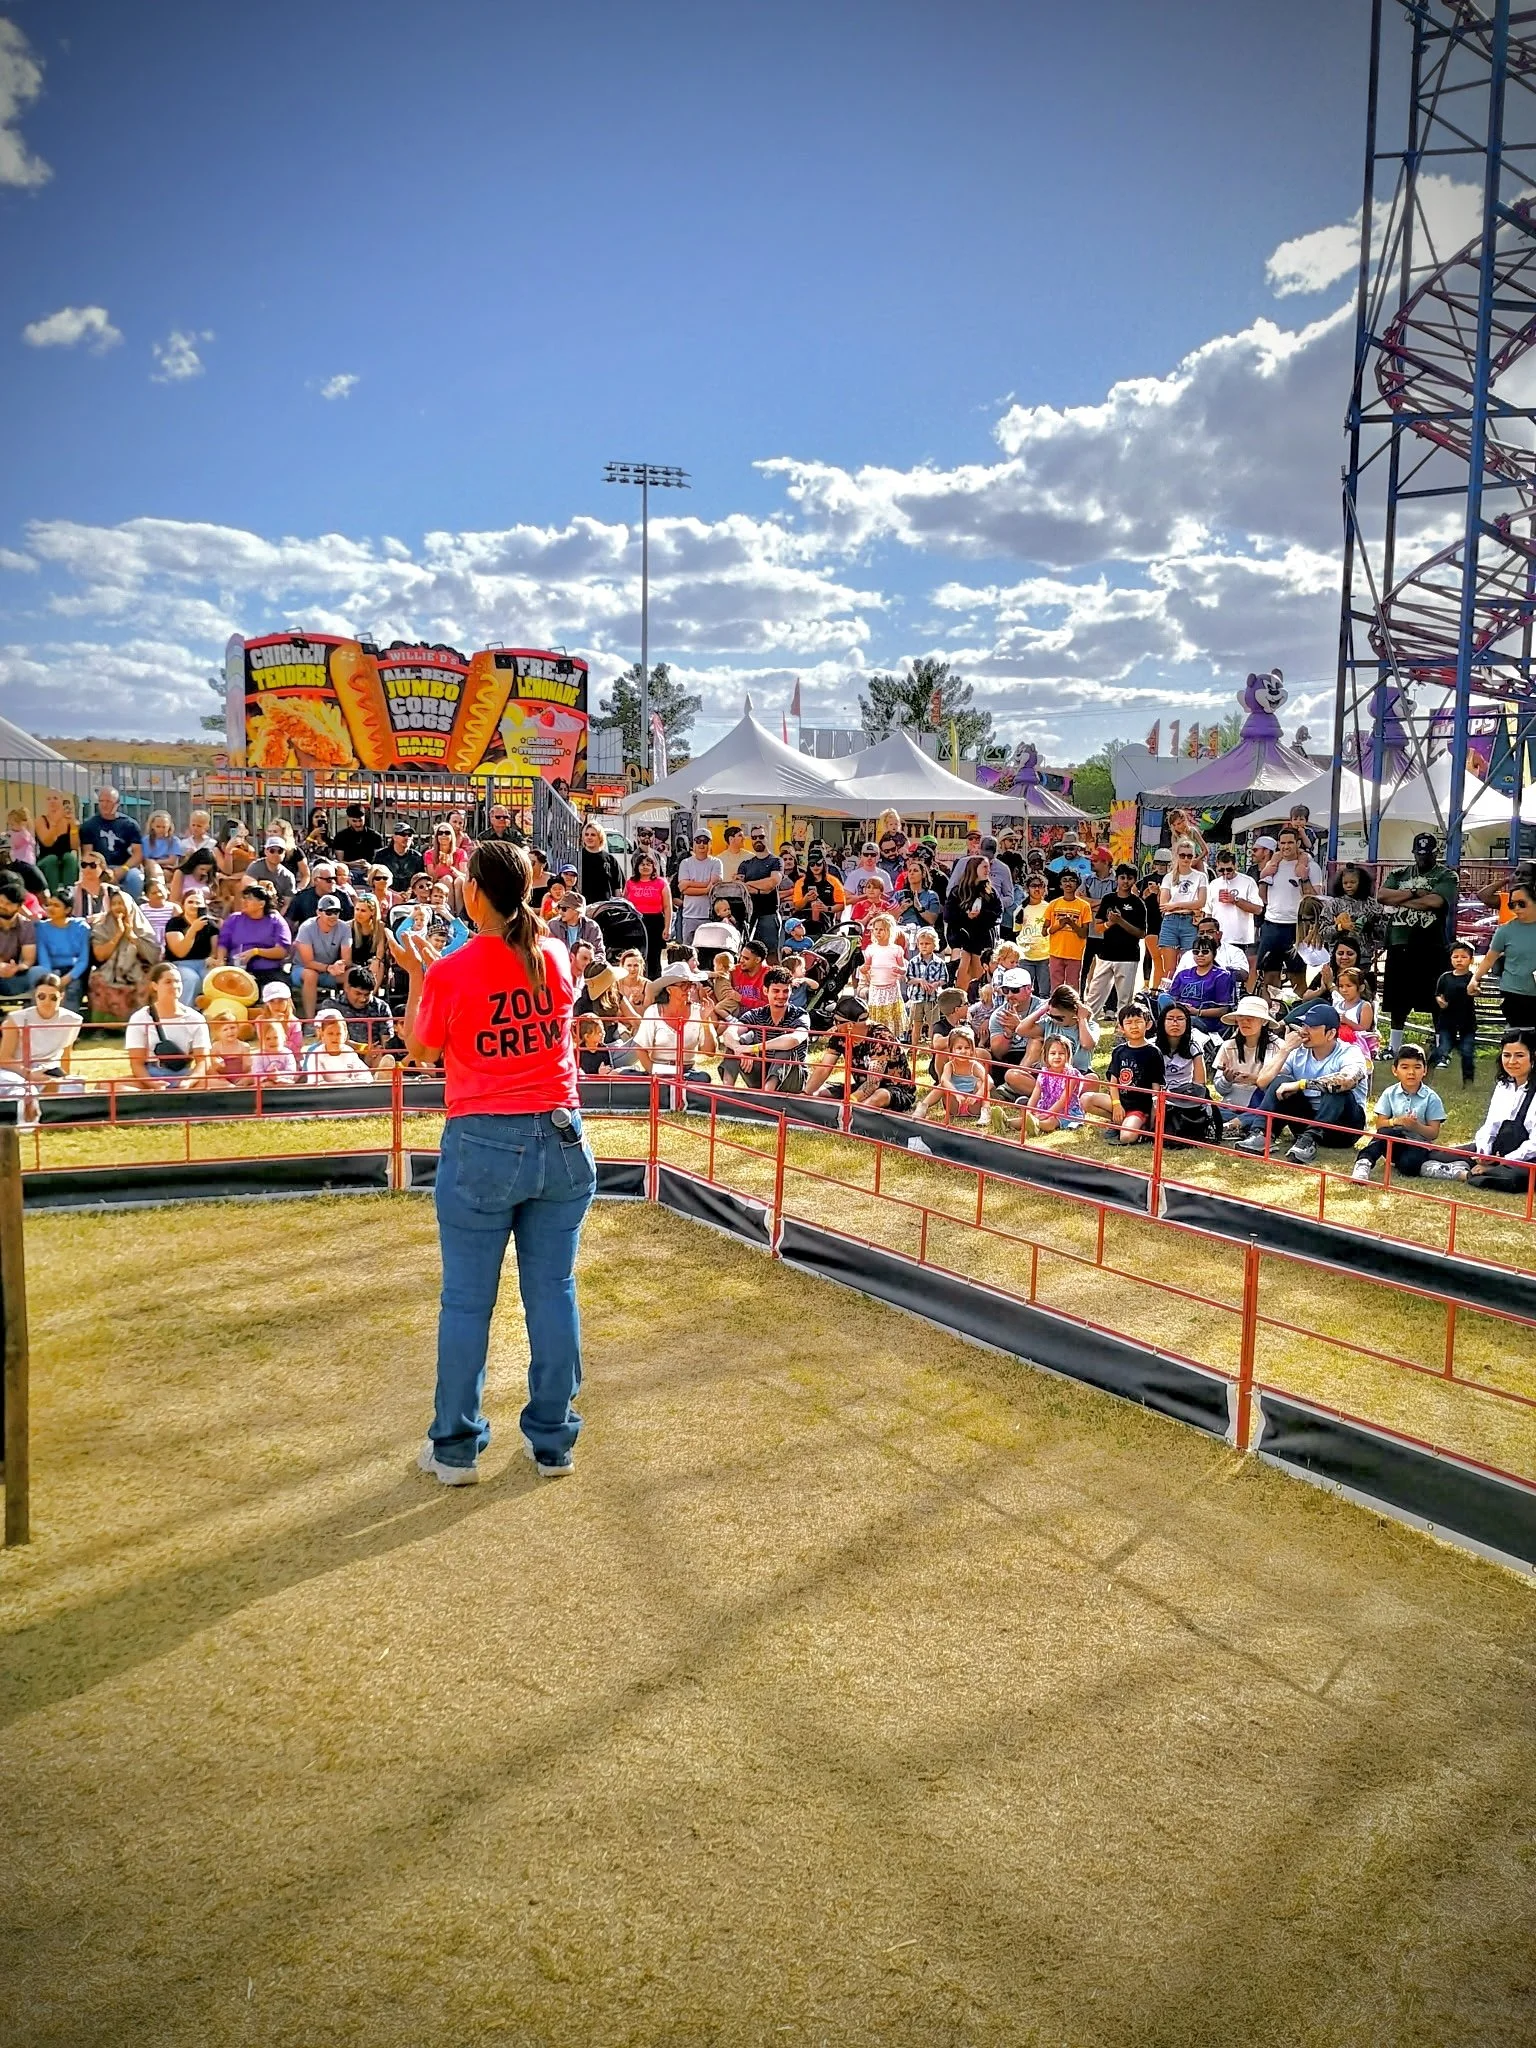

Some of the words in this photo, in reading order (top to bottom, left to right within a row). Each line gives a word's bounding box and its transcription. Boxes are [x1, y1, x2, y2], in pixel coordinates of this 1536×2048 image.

[250, 643, 326, 669] CHICKEN
[391, 652, 435, 662] WILLIE
[251, 664, 327, 690] TENDERS
[383, 668, 465, 684] ALL-BEEF
[386, 680, 460, 701] JUMBO
[517, 676, 581, 707] LEMONADE
[389, 697, 457, 718] CORN
[393, 713, 453, 731] DOGS
[397, 737, 446, 748] HAND
[398, 747, 445, 757] DIPPED
[313, 786, 367, 799] EMONADE
[489, 985, 553, 1025] ZOO
[476, 1019, 562, 1057] CREW
